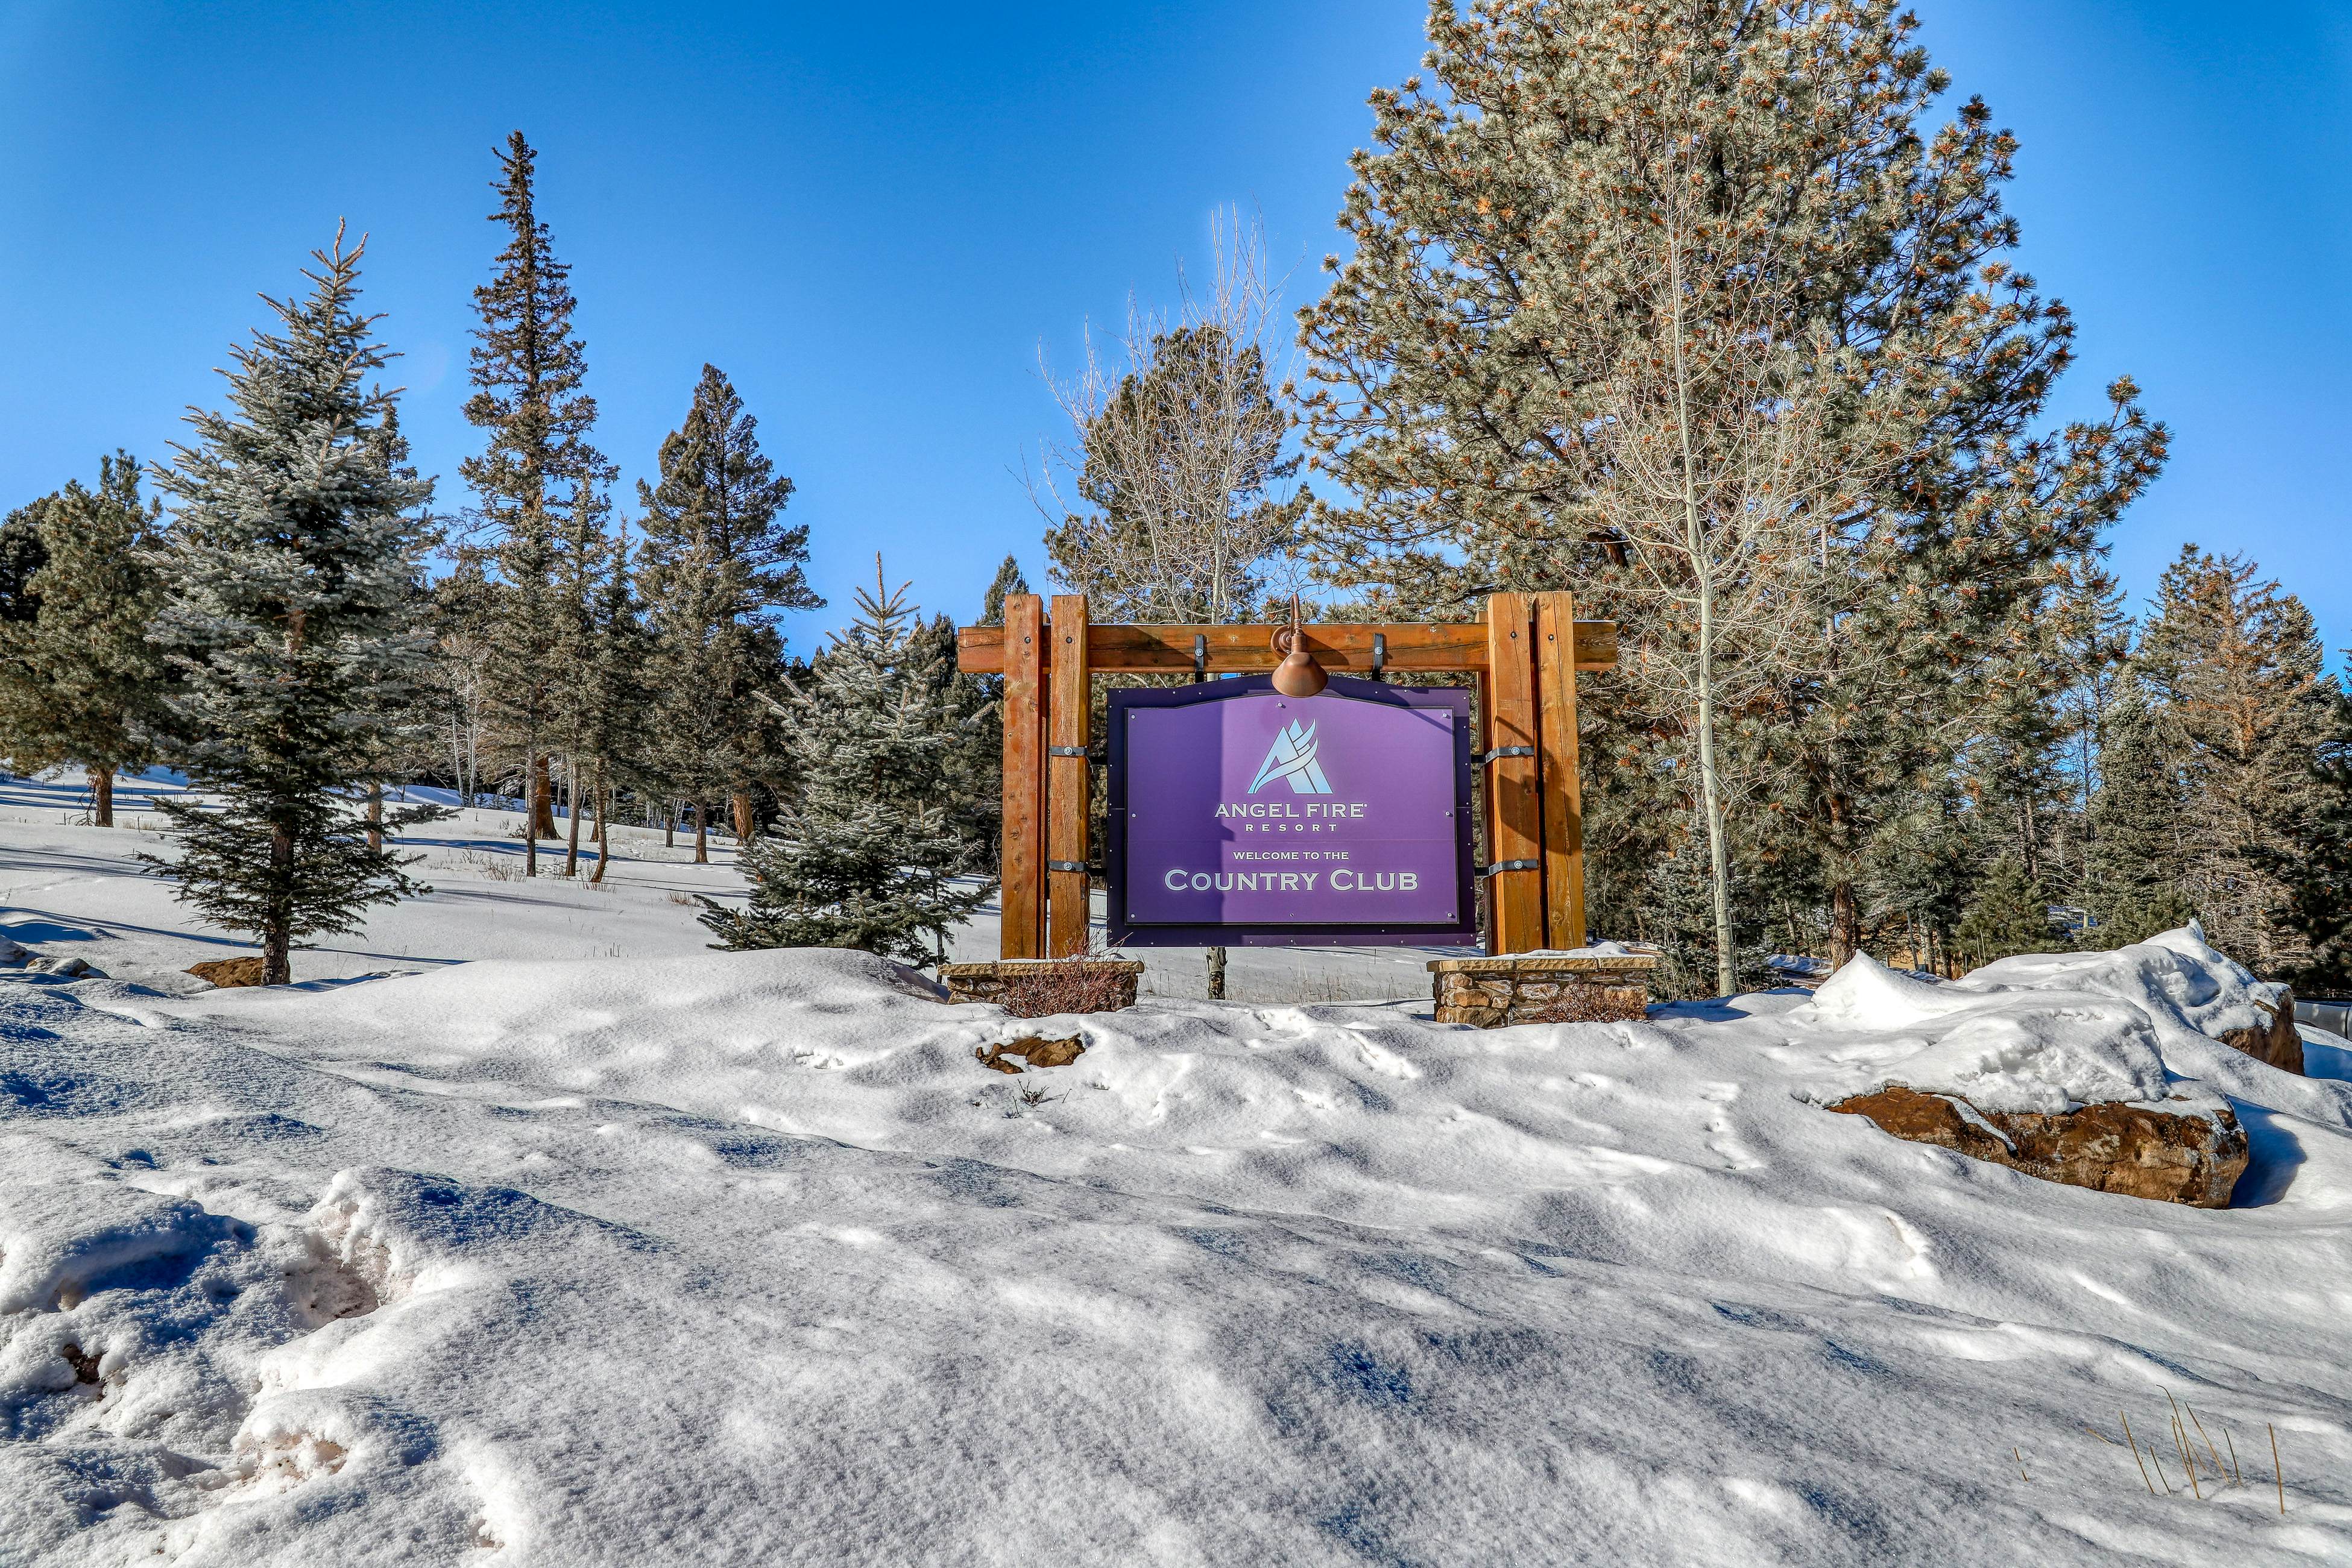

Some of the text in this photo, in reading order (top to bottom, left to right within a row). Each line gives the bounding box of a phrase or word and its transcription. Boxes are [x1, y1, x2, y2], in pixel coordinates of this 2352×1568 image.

[1214, 802, 1300, 817] ANGEL
[1233, 851, 1349, 860] WELCOME TO THE
